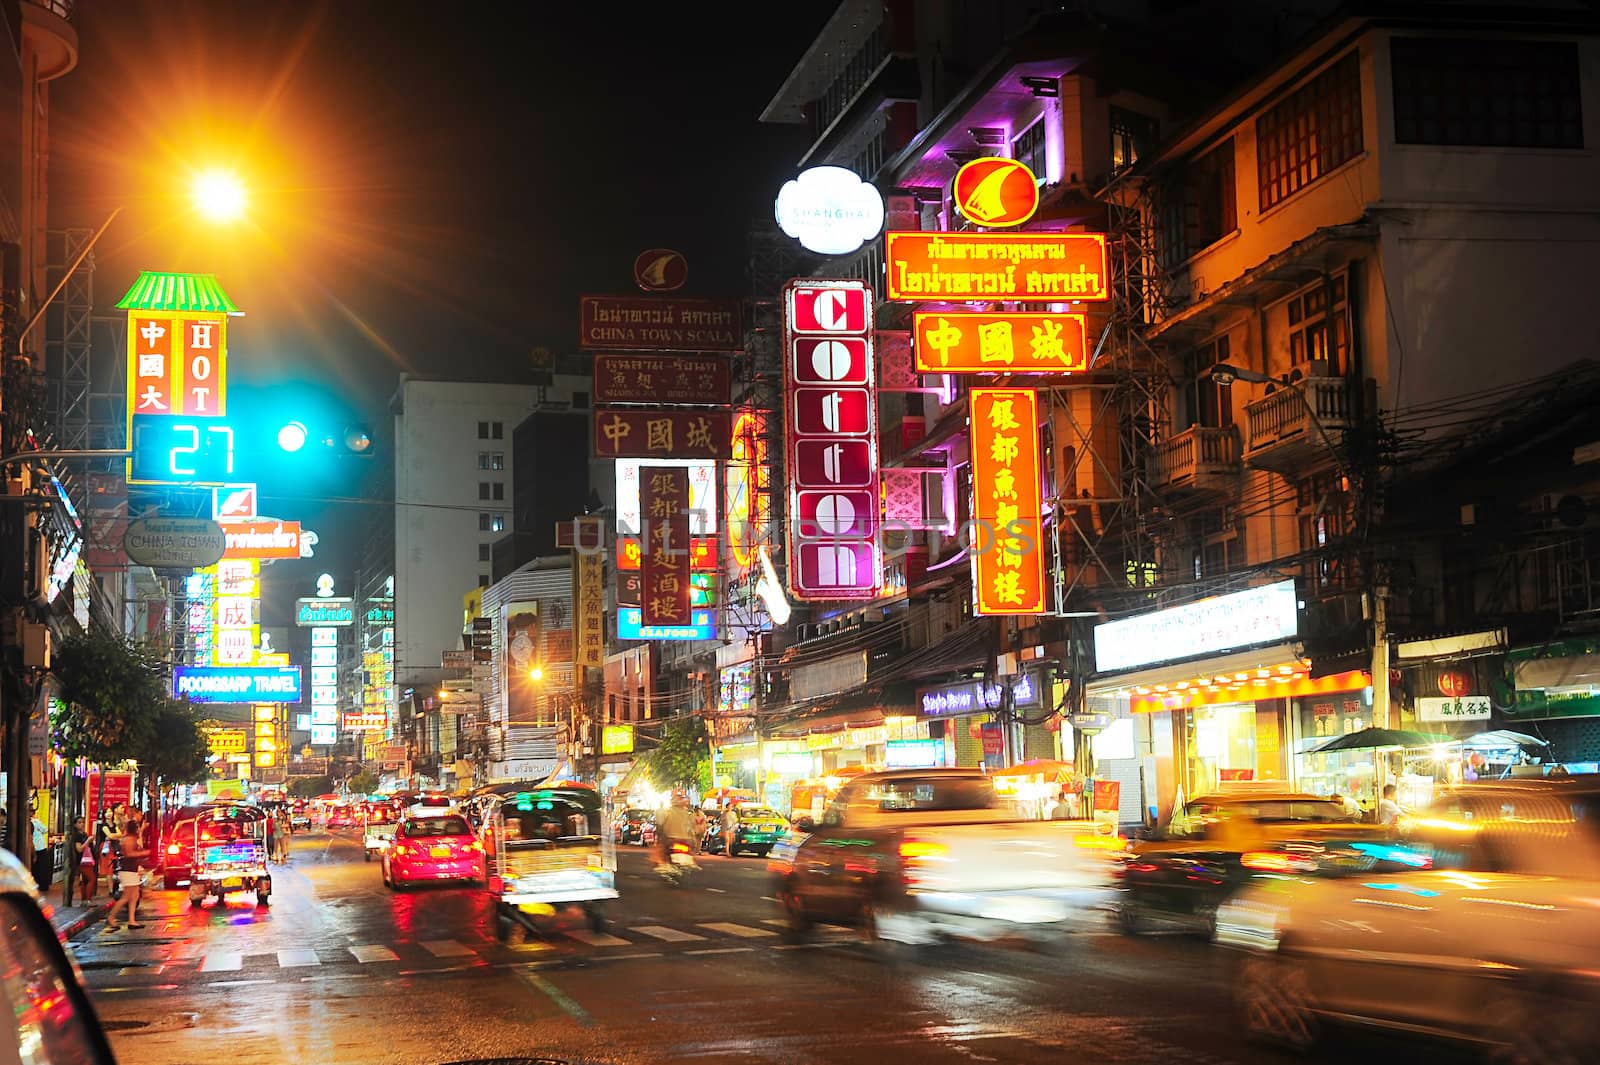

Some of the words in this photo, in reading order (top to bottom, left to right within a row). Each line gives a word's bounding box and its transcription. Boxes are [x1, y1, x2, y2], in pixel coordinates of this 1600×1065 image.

[591, 327, 635, 341] CHINA
[639, 328, 683, 342] TOWN
[687, 329, 735, 343] SCALA
[926, 318, 1073, 367] 中國城
[191, 324, 212, 412] HOT
[169, 424, 235, 475] 27
[603, 416, 719, 454] 中國城
[131, 535, 174, 549] CHINA
[181, 535, 221, 549] TOWN
[253, 676, 297, 692] TRAVEL
